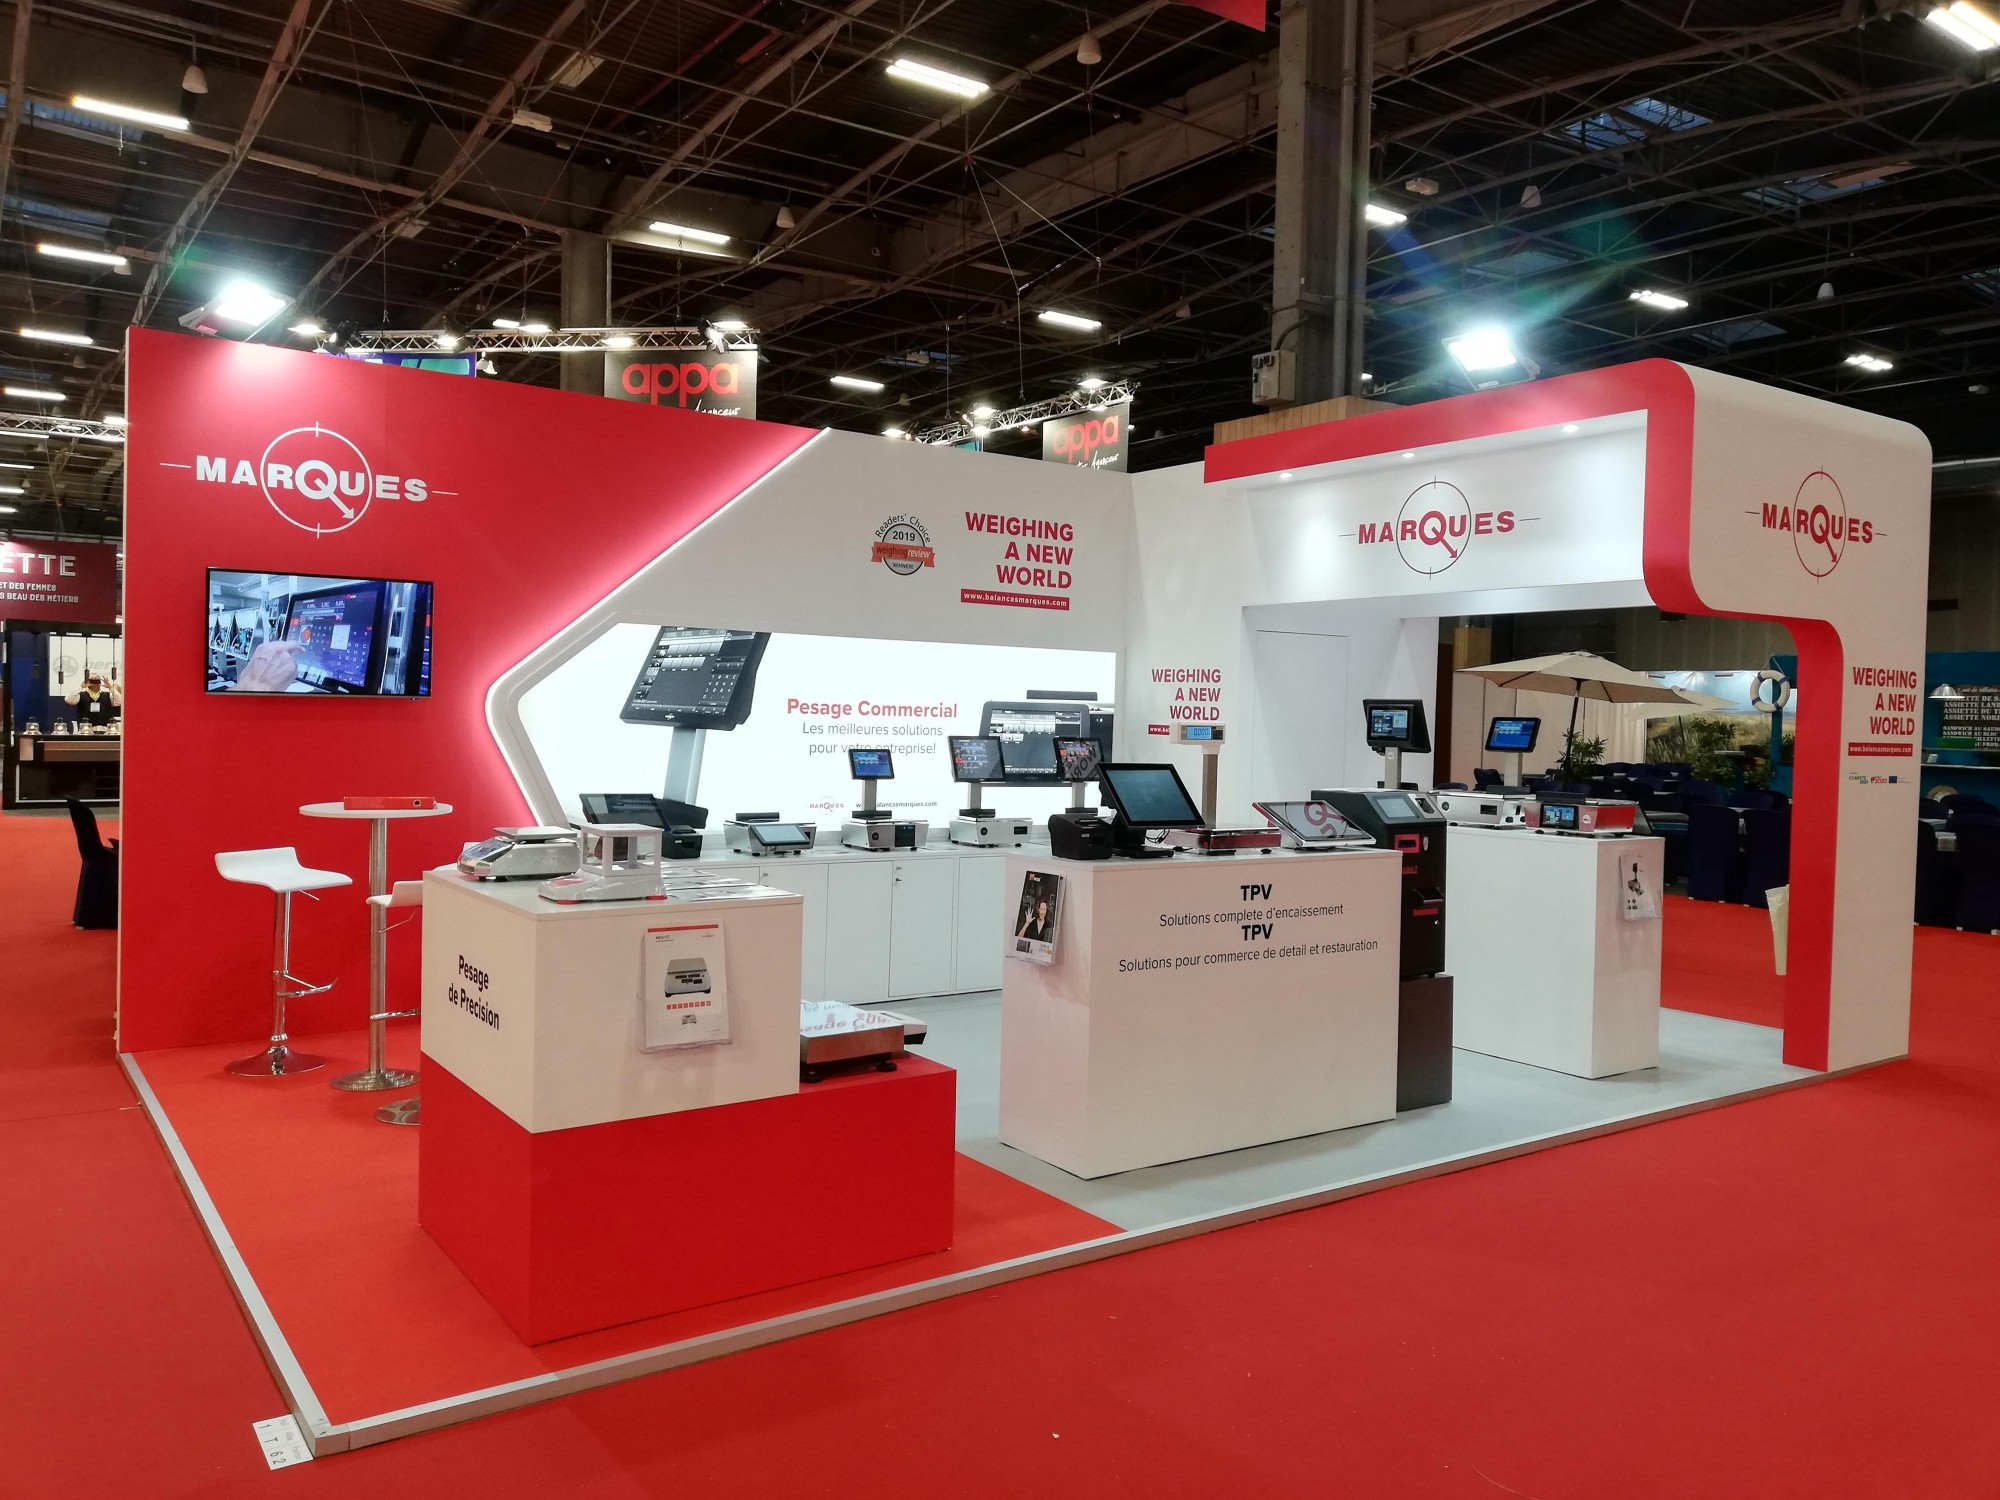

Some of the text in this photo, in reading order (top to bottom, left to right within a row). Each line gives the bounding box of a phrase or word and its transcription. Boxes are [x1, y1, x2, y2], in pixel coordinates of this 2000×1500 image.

[622, 362, 738, 407] appa
[1053, 415, 1119, 463] appa
[195, 455, 428, 518] MARQUES
[874, 513, 931, 543] Readers' Choice
[892, 530, 916, 542] 2019
[965, 511, 1074, 542] WEIGHING
[1358, 510, 1515, 558] MARQUES
[1762, 503, 1873, 562] MARQUES
[1004, 541, 1074, 565] A NEW
[9, 582, 24, 590] DES
[26, 583, 57, 592] FEMMES
[996, 564, 1072, 589] WORLD
[7, 592, 28, 601] BEAU
[29, 593, 45, 602] DES
[963, 592, 1067, 607] www.balancasmarques.com
[1151, 668, 1221, 684] WEIGHING
[1853, 666, 1917, 689] WEIGHING
[1174, 687, 1221, 702] A NEW
[1875, 692, 1917, 712] A NEW
[787, 698, 958, 719] Pesage Commercial
[1169, 705, 1220, 721] WORLD
[802, 721, 944, 736] Les meilleures solutions
[1869, 716, 1916, 736] WORLD
[809, 744, 838, 756] pour
[809, 802, 844, 812] MARQUES
[1240, 884, 1272, 901] TPV
[1160, 904, 1344, 927] Solutions complete d'encaissement
[1241, 923, 1273, 941] TPV
[1119, 939, 1378, 973] Solutions pour commerce de detail et restauration
[459, 954, 489, 992] Pesage
[448, 982, 500, 1031] de Precision
